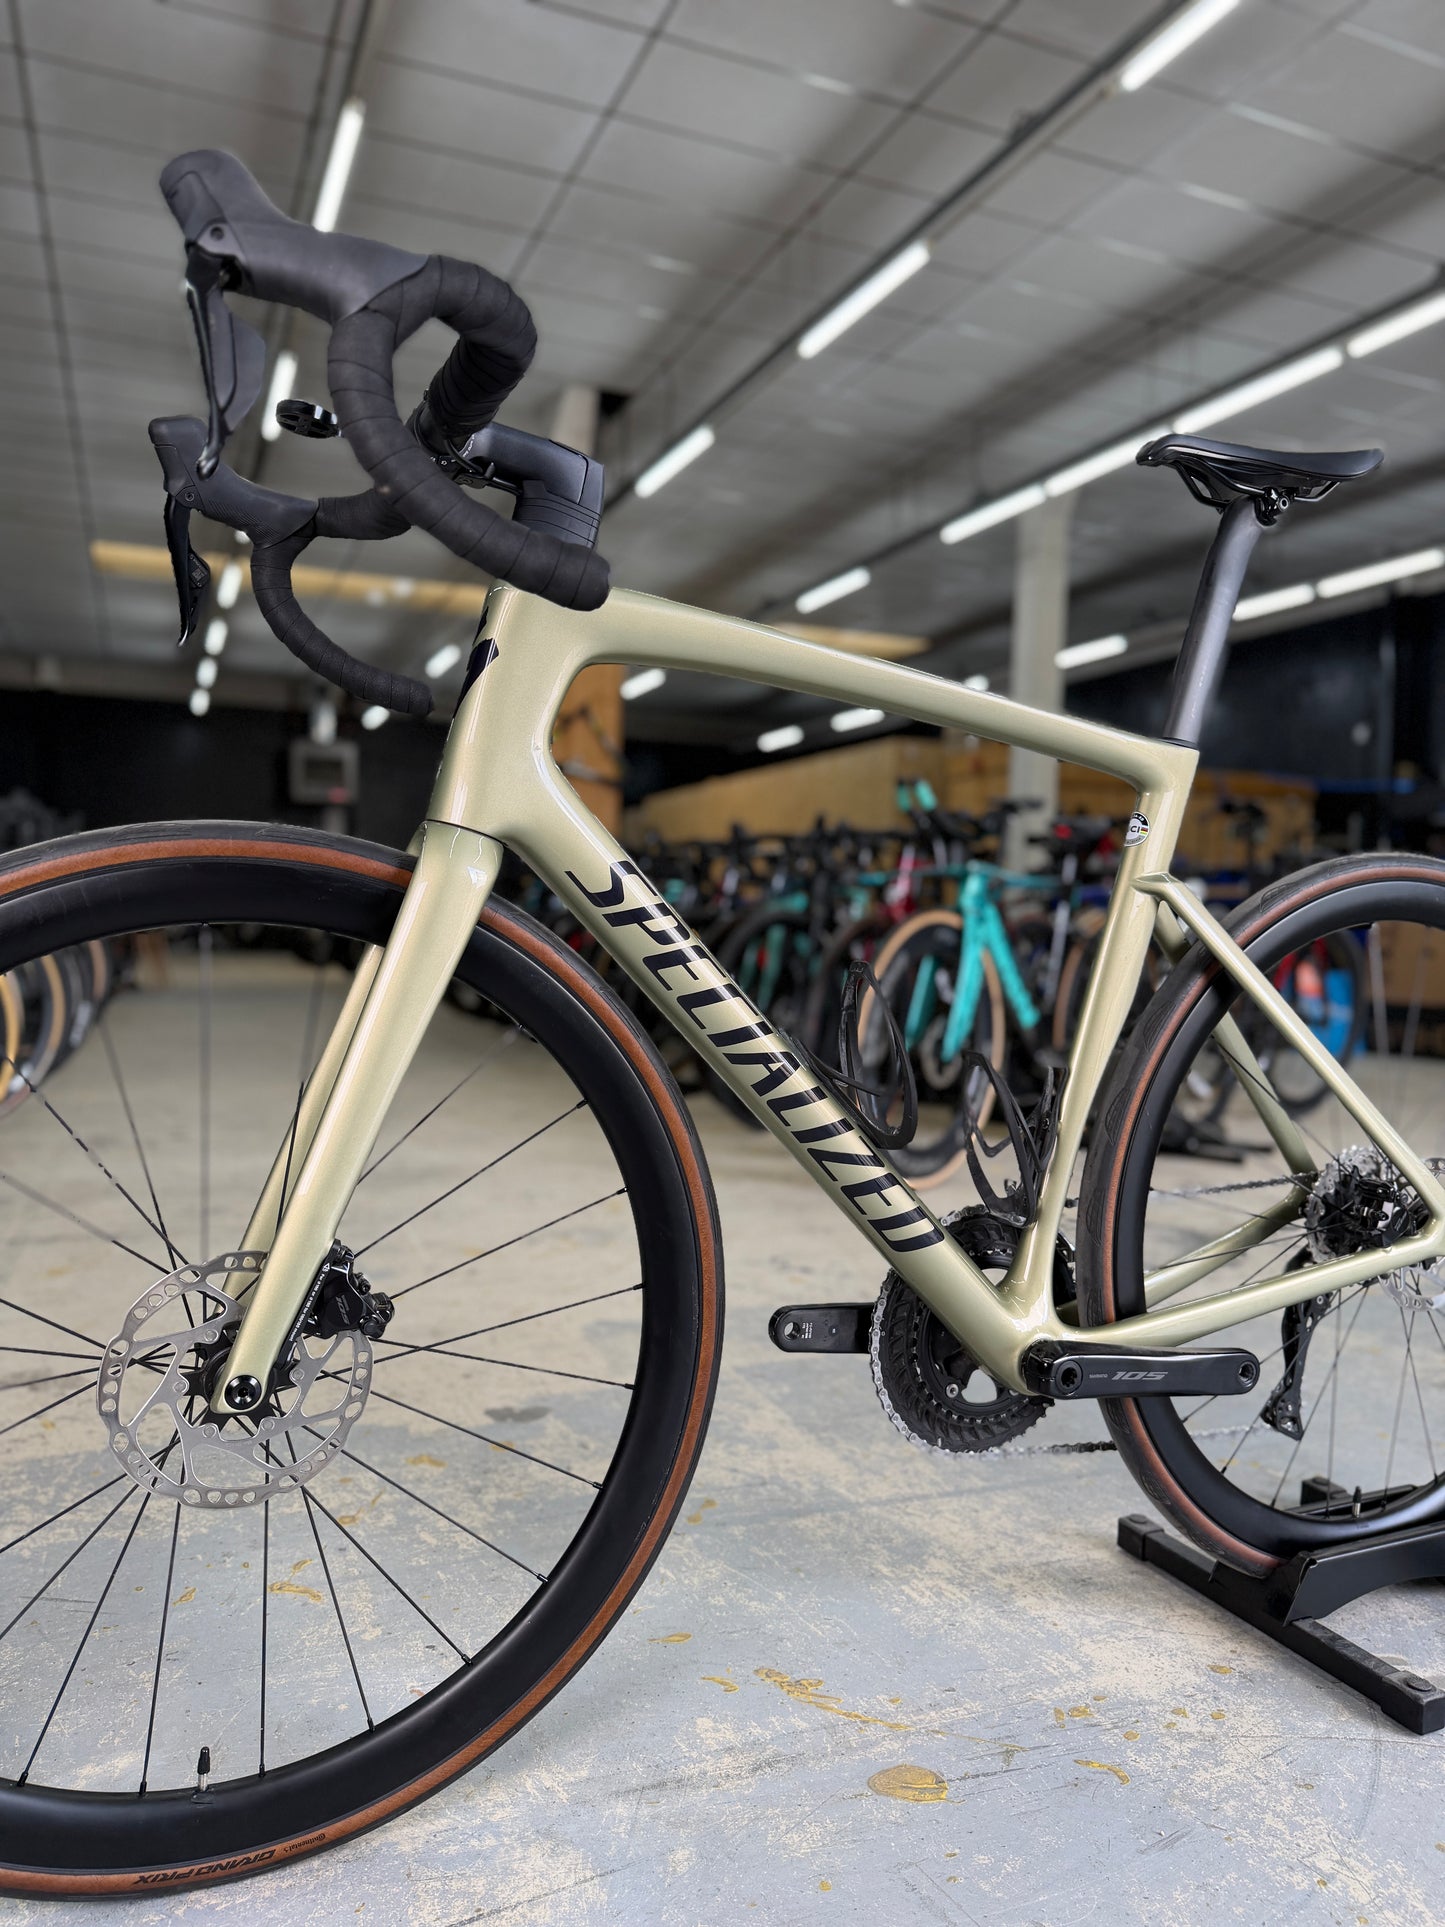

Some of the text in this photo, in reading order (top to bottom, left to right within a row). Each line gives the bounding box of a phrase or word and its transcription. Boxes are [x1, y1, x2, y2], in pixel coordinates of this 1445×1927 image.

[564, 860, 945, 1252] SPECIALIZED
[1111, 1371, 1168, 1381] 105
[194, 1849, 276, 1876] GRAND
[133, 1868, 195, 1885] PRIX
